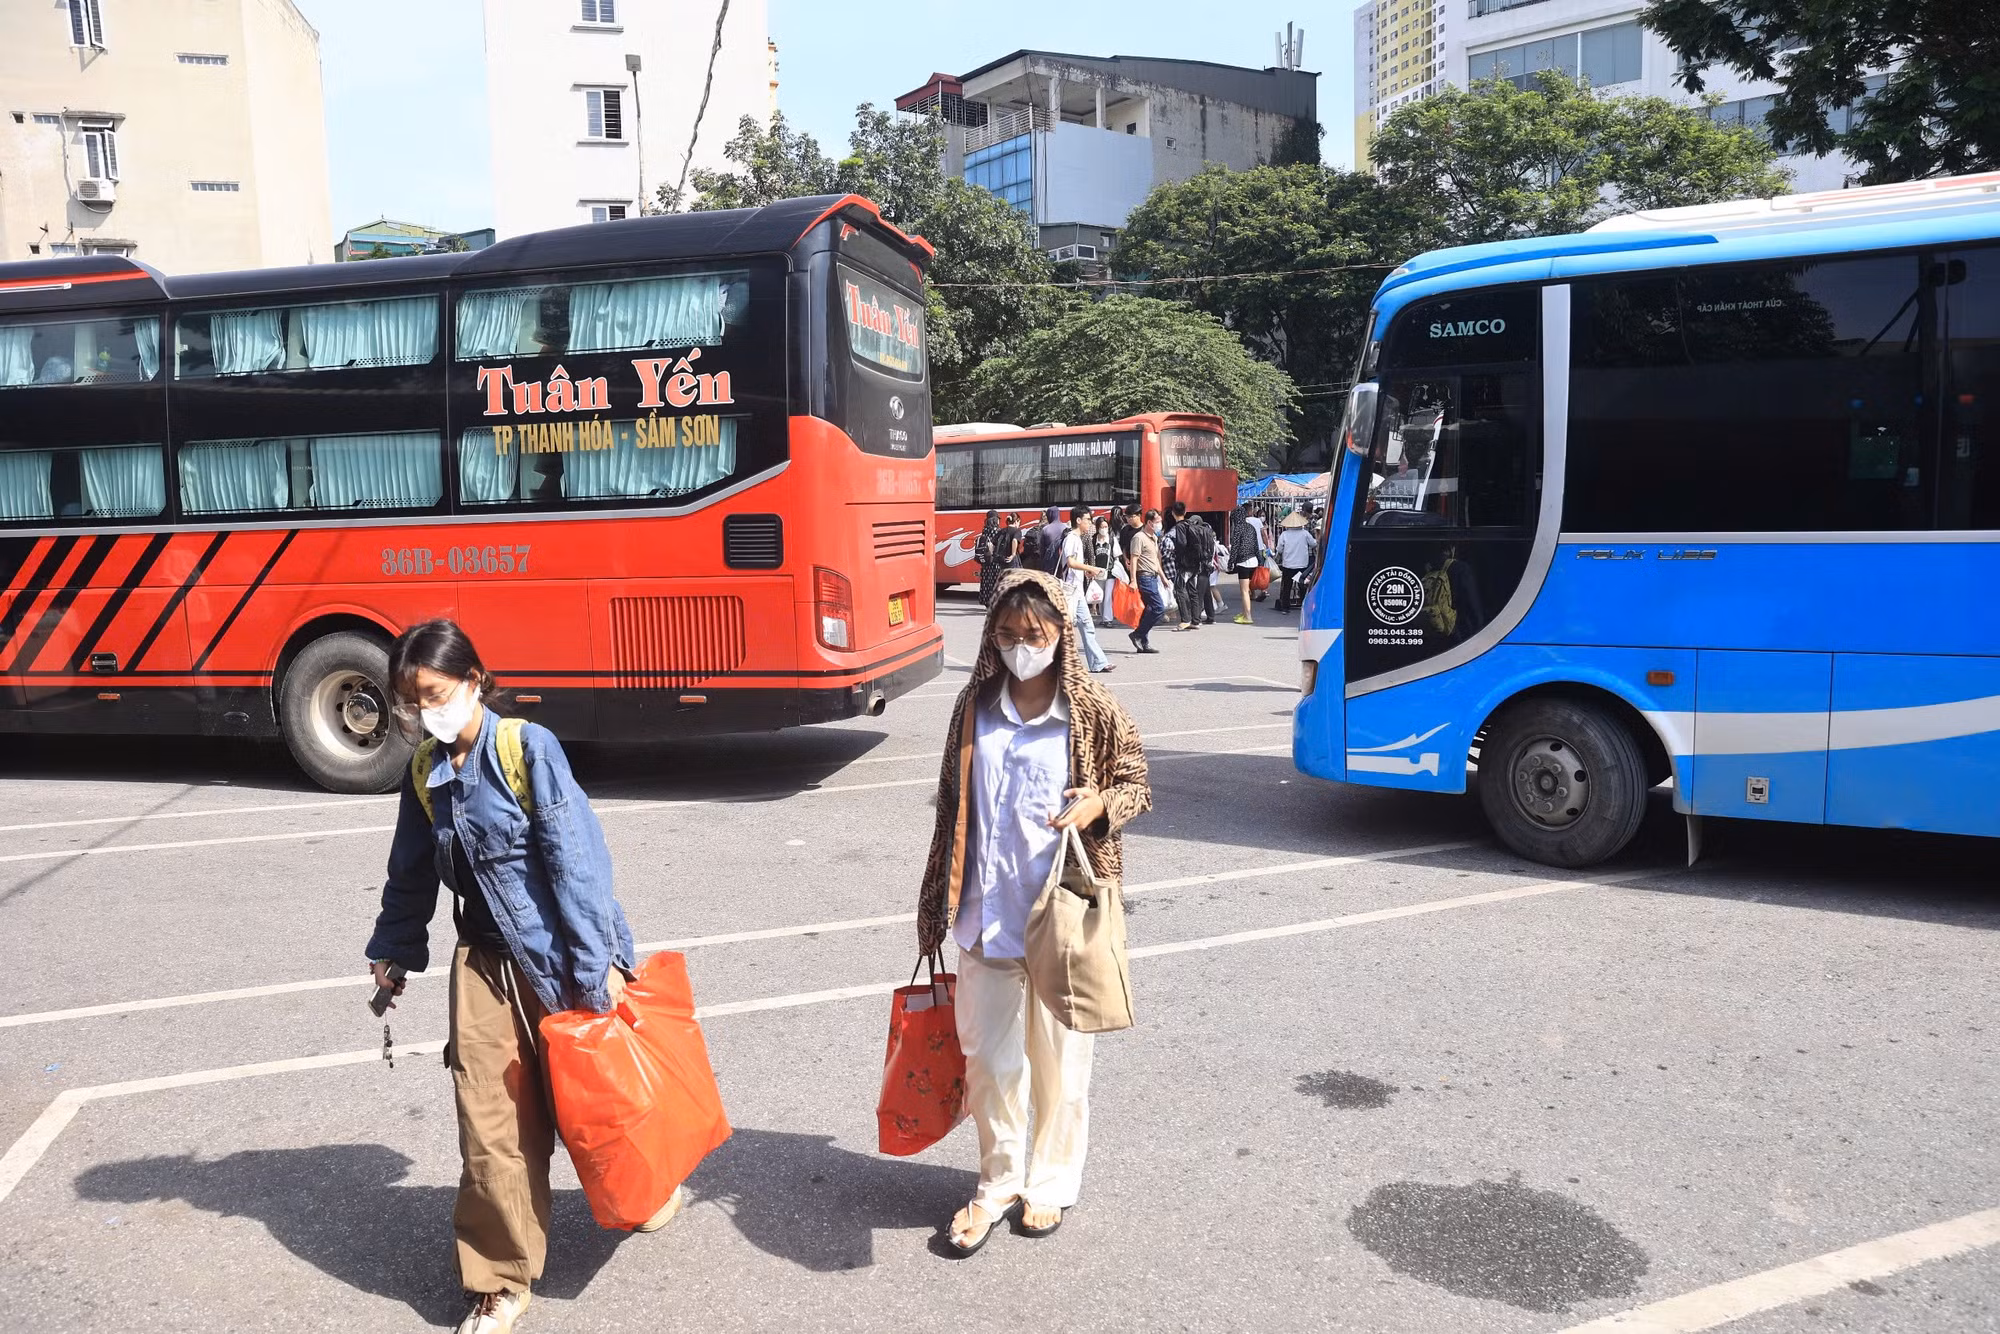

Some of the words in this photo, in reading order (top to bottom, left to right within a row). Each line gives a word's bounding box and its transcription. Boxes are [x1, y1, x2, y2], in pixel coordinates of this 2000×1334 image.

[845, 279, 892, 336] Tuân
[1429, 318, 1506, 338] SAMCO
[476, 364, 612, 416] Tuân
[631, 347, 735, 408] Yến
[492, 425, 513, 456] TP
[518, 421, 574, 454] THANH
[579, 414, 615, 450] HÓA
[621, 431, 628, 440] -
[635, 407, 676, 449] SẦM
[681, 413, 720, 447] SƠN
[1049, 441, 1066, 458] THÁI
[1090, 438, 1101, 456] HÀ
[1101, 437, 1116, 458] NỘI
[1166, 452, 1182, 467] THÁI
[381, 544, 532, 576] 36B-03657
[1576, 549, 1647, 560] FELIX
[1386, 584, 1405, 594] 29N
[1368, 628, 1423, 636] 0963.045.389
